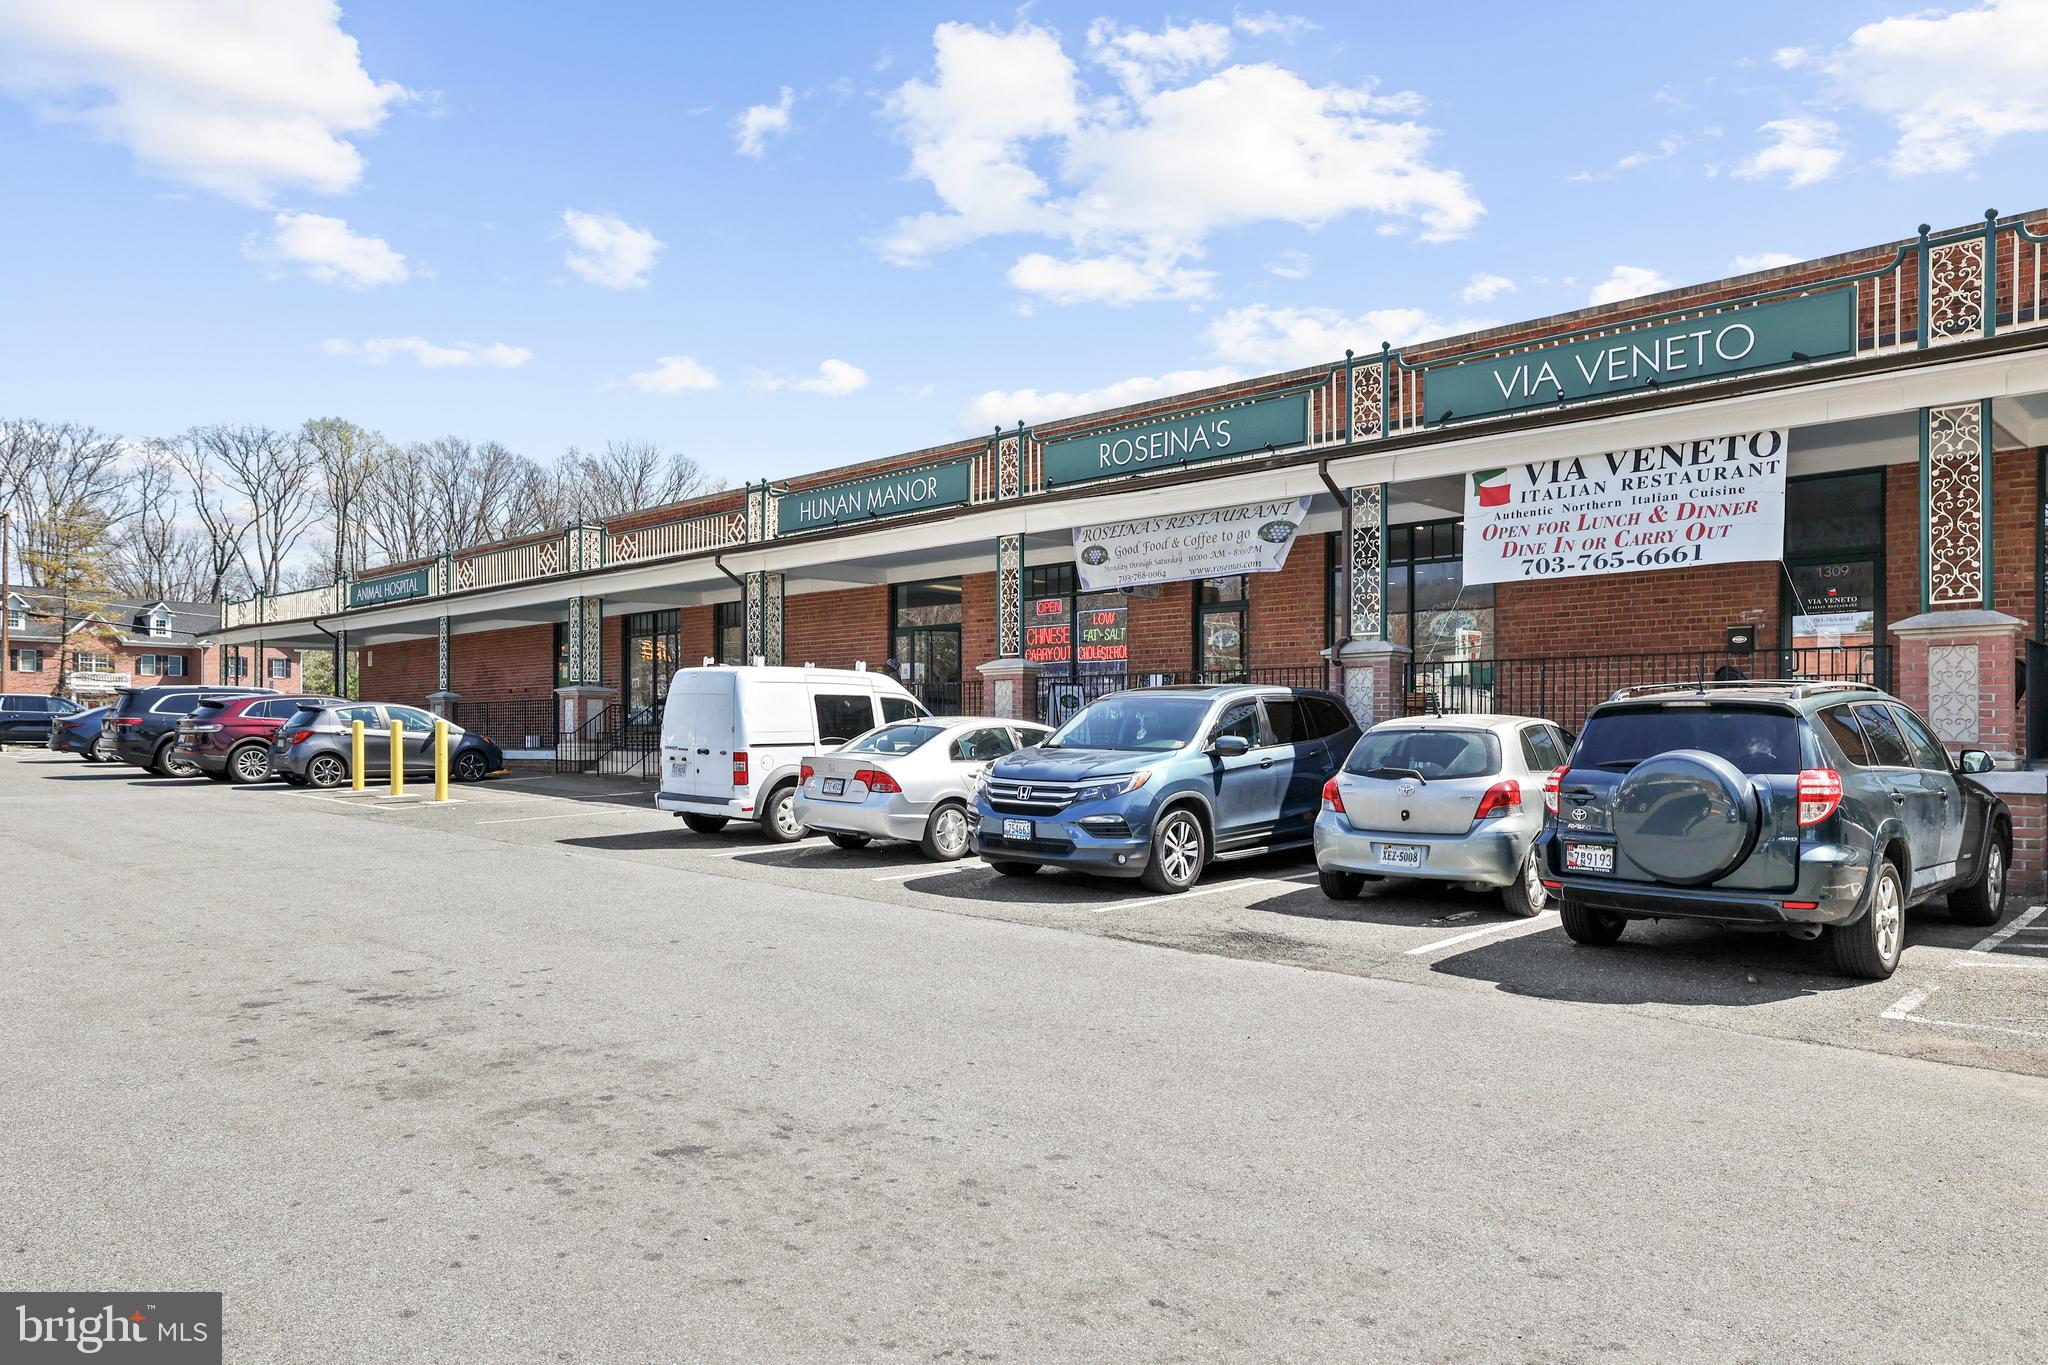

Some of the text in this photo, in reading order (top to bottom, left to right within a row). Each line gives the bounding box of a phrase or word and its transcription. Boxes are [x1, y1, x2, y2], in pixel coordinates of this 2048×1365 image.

[1494, 323, 1755, 400] VIA VENETO
[1100, 419, 1231, 469] ROSEINA'S
[1525, 430, 1782, 486] VIA VENETO
[1520, 459, 1780, 504] ITALIAN RESTAURANT
[800, 477, 937, 522] HUNAN MANOR
[1494, 484, 1746, 521] Authentic Northern Italian Cuisine
[1082, 501, 1295, 543] ROSEINA'S RESTAURANT
[1482, 498, 1760, 542] OPEN FOR LUNCH & DINNER
[1114, 529, 1251, 559] Good Food & Coffee to go
[1501, 522, 1733, 559] DINE IN OR CARRY OUT
[1129, 558, 1153, 569] through
[1154, 554, 1183, 566] Saturday
[1210, 549, 1226, 559] AM
[1521, 544, 1704, 576] 703-765-6661
[1817, 565, 1849, 578] 1309
[356, 578, 418, 601] ANIMAL HOSPITAL
[1118, 570, 1167, 583] 703-768-0064
[1038, 601, 1062, 614] OPEN
[1824, 595, 1858, 604] VENETO
[1092, 612, 1116, 625] LOW
[1026, 626, 1070, 645] CHINESE
[1567, 823, 1592, 831] RAV4
[1382, 850, 1418, 862] XEZ-5008
